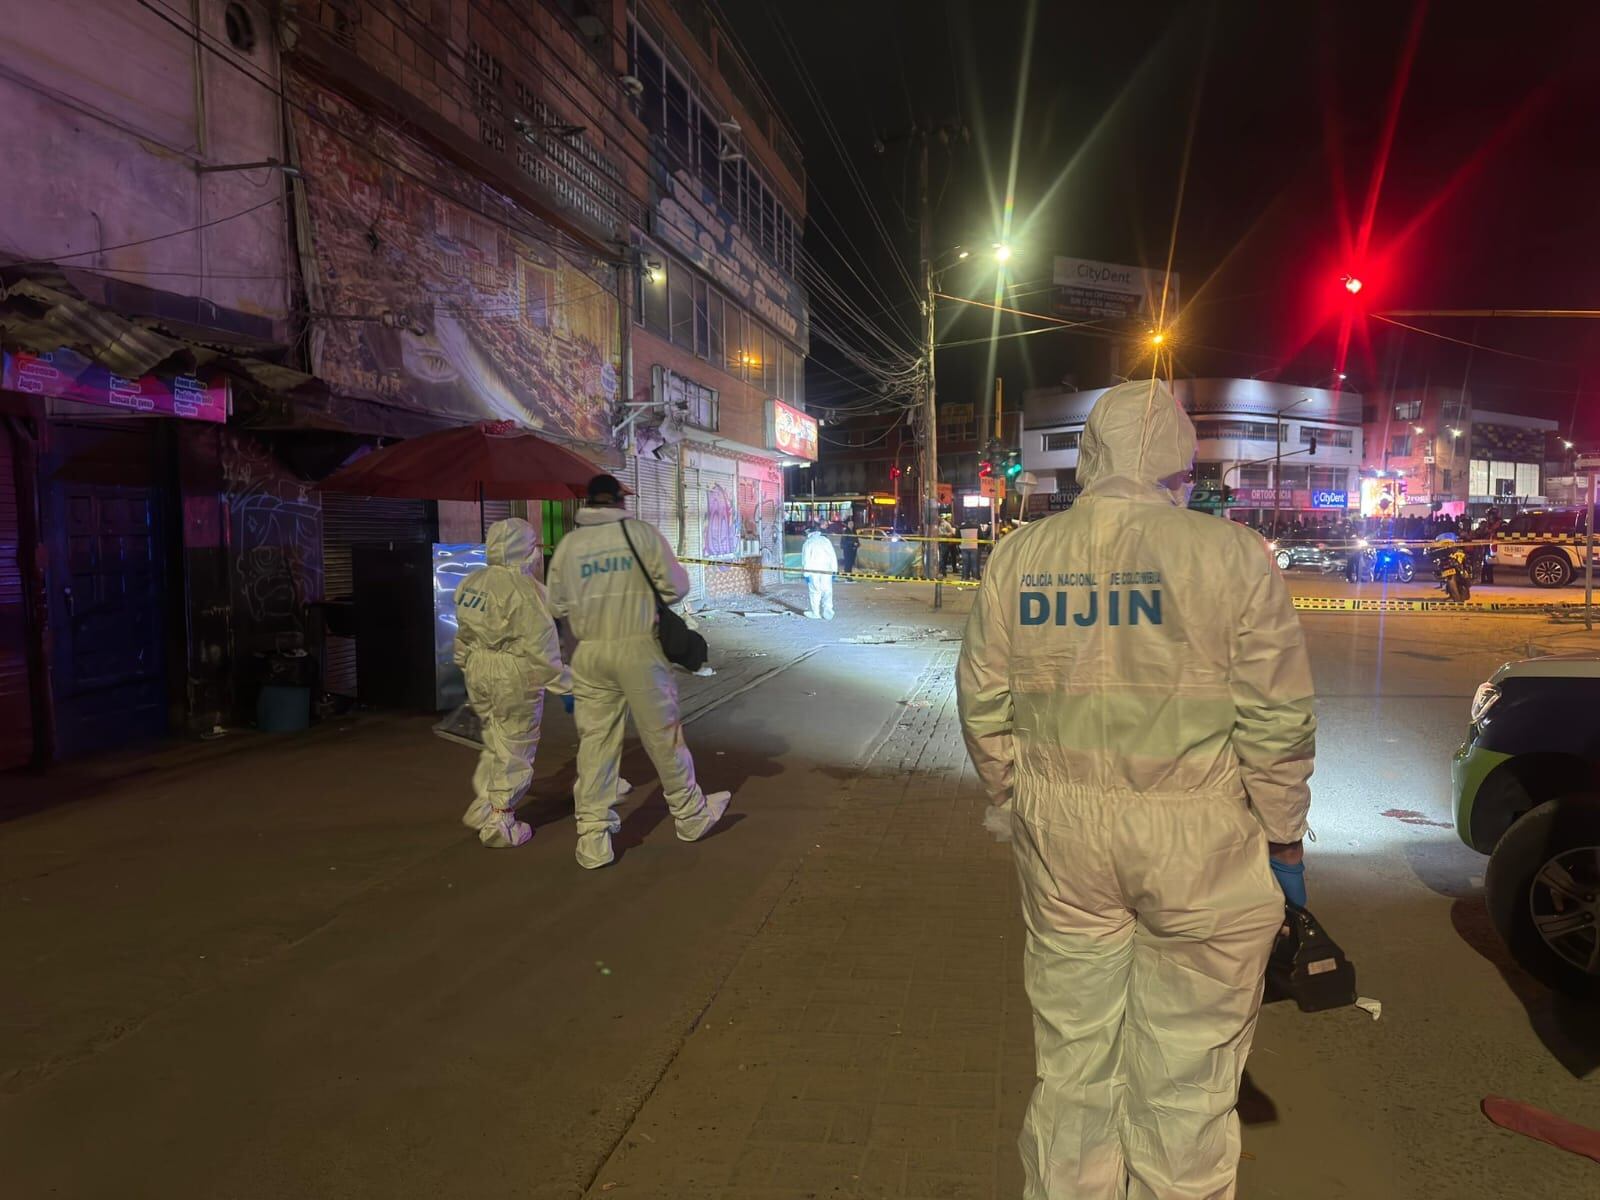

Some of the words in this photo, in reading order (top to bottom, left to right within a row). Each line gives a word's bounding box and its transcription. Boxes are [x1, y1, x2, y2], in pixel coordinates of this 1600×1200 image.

[1077, 263, 1131, 283] CityDent
[1319, 492, 1345, 504] CityDent
[581, 556, 633, 579] DIJIN
[1019, 590, 1163, 627] DIJIN
